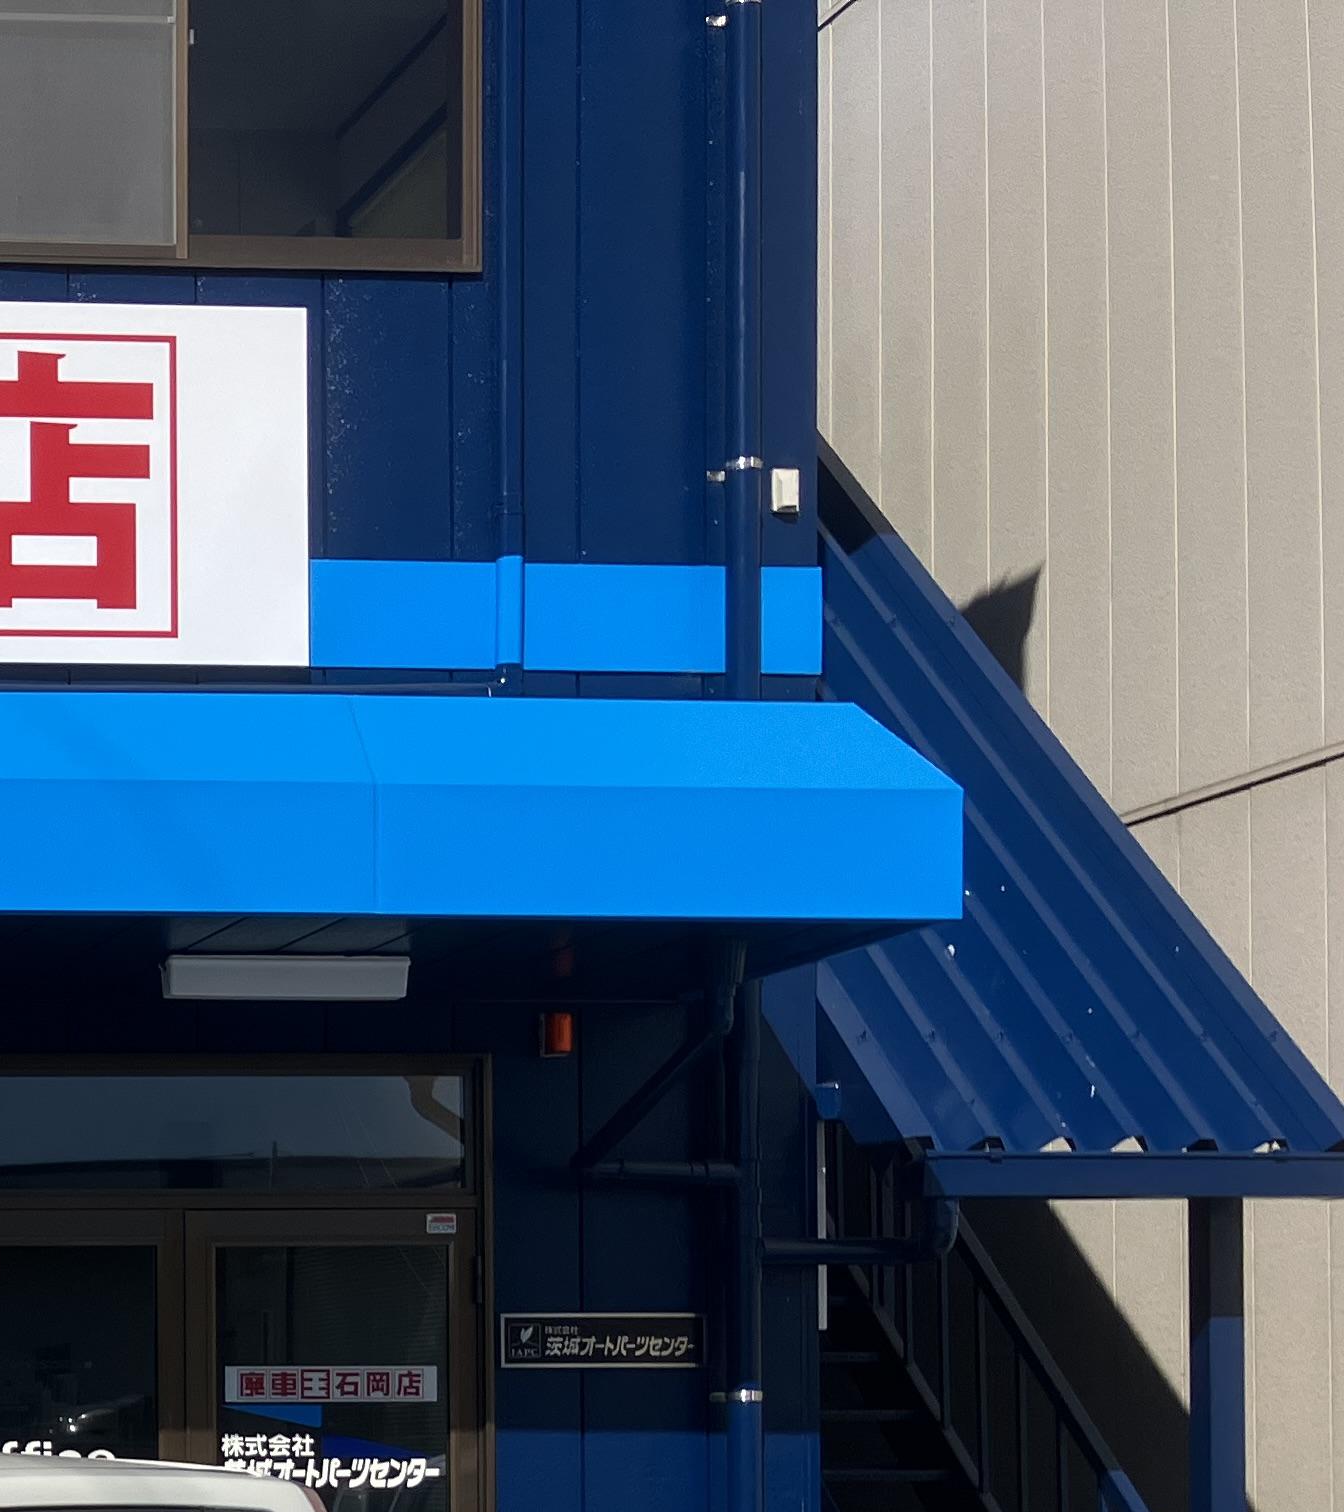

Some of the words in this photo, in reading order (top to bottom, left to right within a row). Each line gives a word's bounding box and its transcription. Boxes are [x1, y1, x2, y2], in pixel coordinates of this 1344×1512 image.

[544, 1335, 695, 1357] 茨城オートパーツセンター
[239, 1369, 424, 1399] 廃車王石岡店
[221, 1433, 315, 1458] 株式会社
